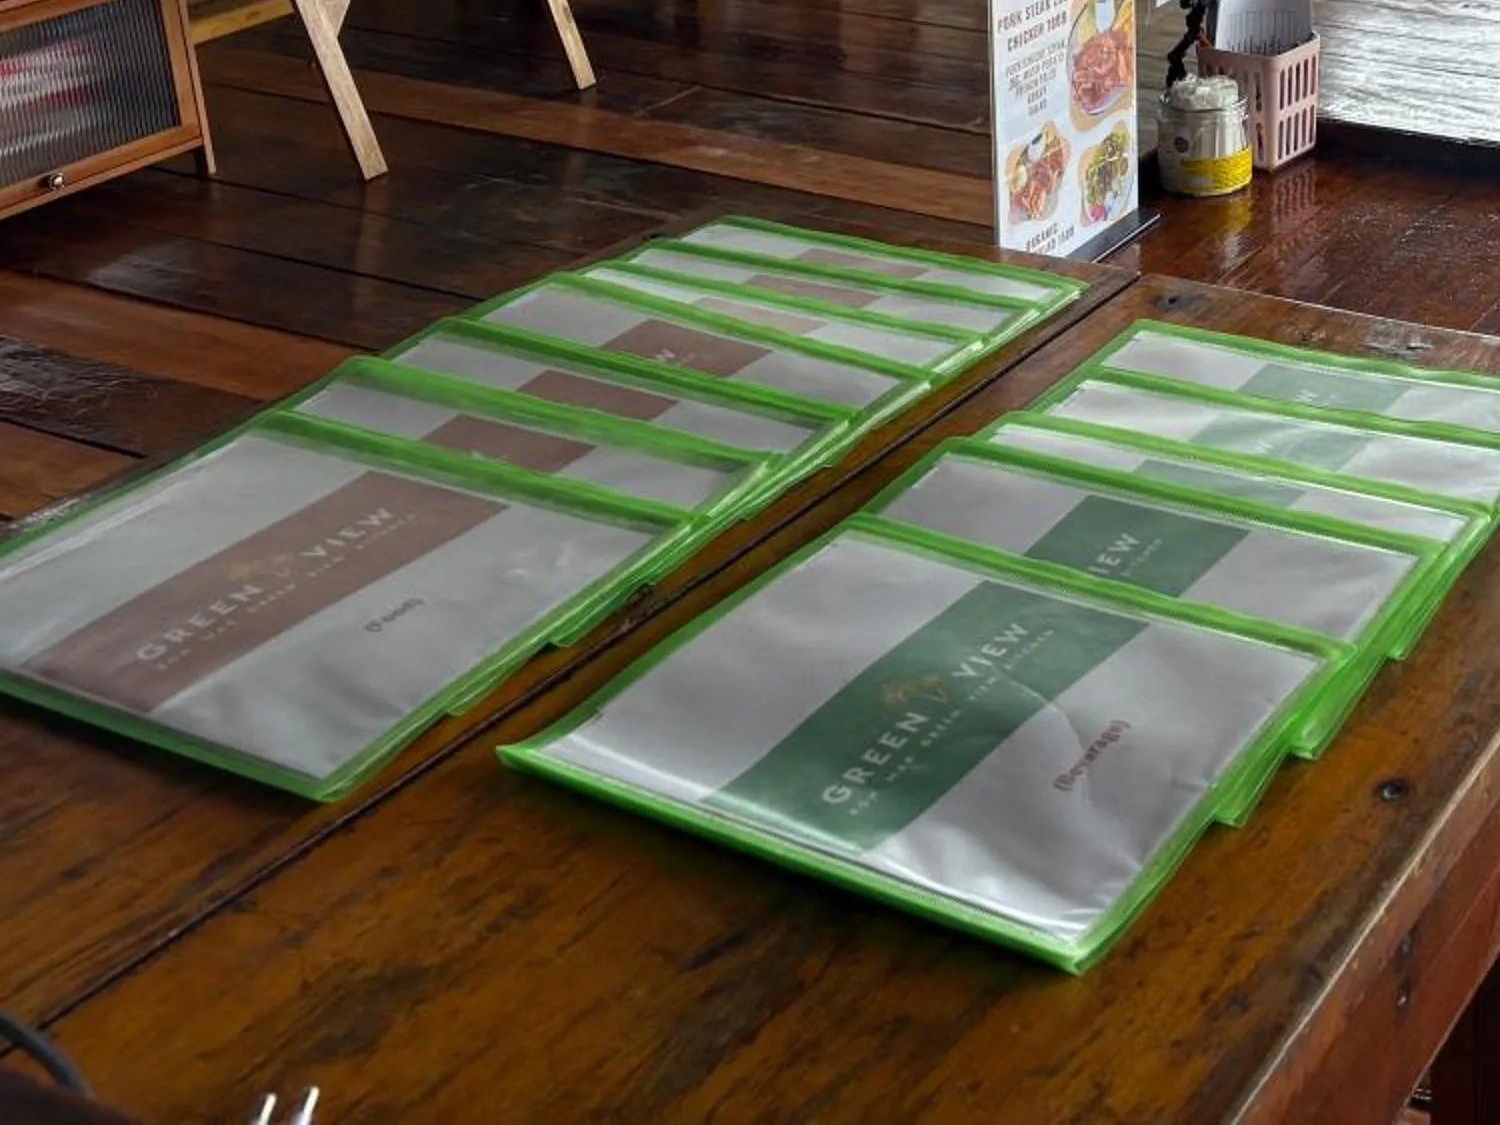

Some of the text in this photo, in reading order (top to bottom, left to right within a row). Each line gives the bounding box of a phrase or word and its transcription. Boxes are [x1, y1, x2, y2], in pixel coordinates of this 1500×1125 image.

[997, 10, 1022, 33] PORK
[1007, 23, 1044, 52] CHICKEN
[1087, 532, 1140, 574] IEW
[137, 507, 393, 660] GREEN VIEW
[822, 623, 1029, 804] GREEN VIEW
